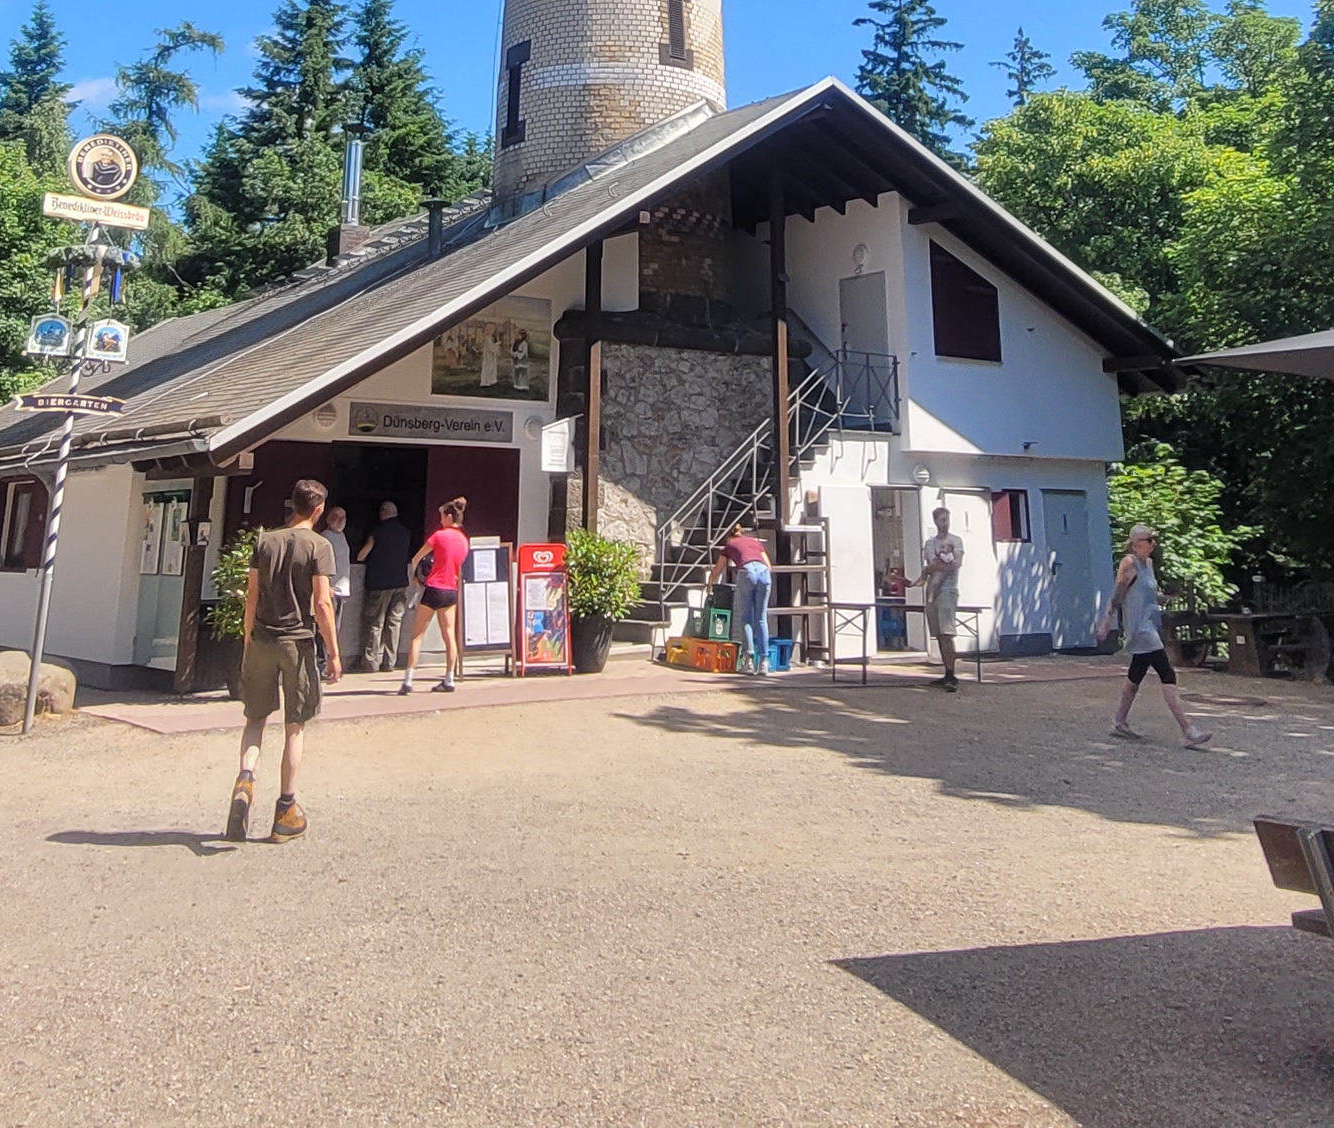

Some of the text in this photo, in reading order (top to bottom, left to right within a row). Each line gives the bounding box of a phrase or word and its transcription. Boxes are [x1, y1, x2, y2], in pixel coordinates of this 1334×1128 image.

[76, 139, 132, 171] BENEDIKTINER
[37, 399, 108, 410] BIERGARTEN
[383, 415, 505, 433] Dünsberg-Verein e.V.
